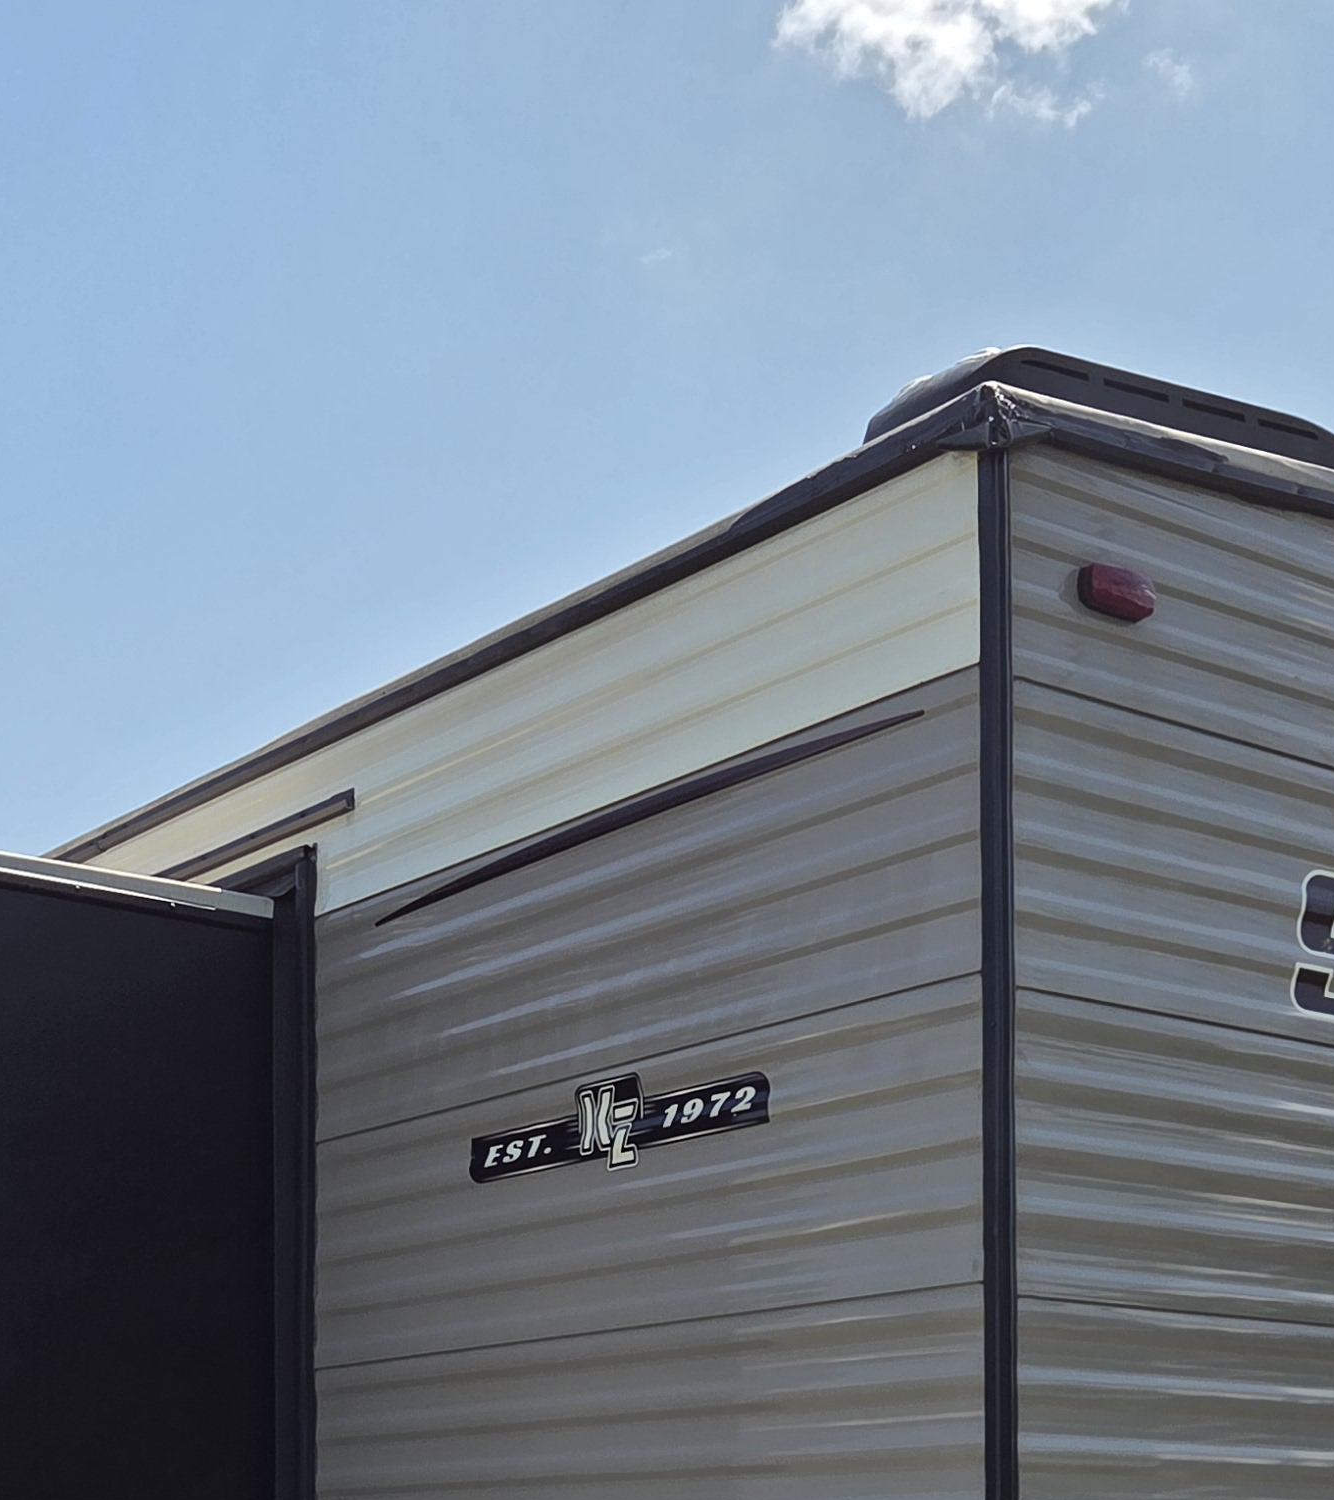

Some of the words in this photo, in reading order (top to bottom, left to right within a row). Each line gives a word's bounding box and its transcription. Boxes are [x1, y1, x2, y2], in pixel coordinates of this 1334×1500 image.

[483, 1134, 553, 1169] EST.
[578, 1084, 639, 1172] KZ
[661, 1085, 757, 1129] 1972
